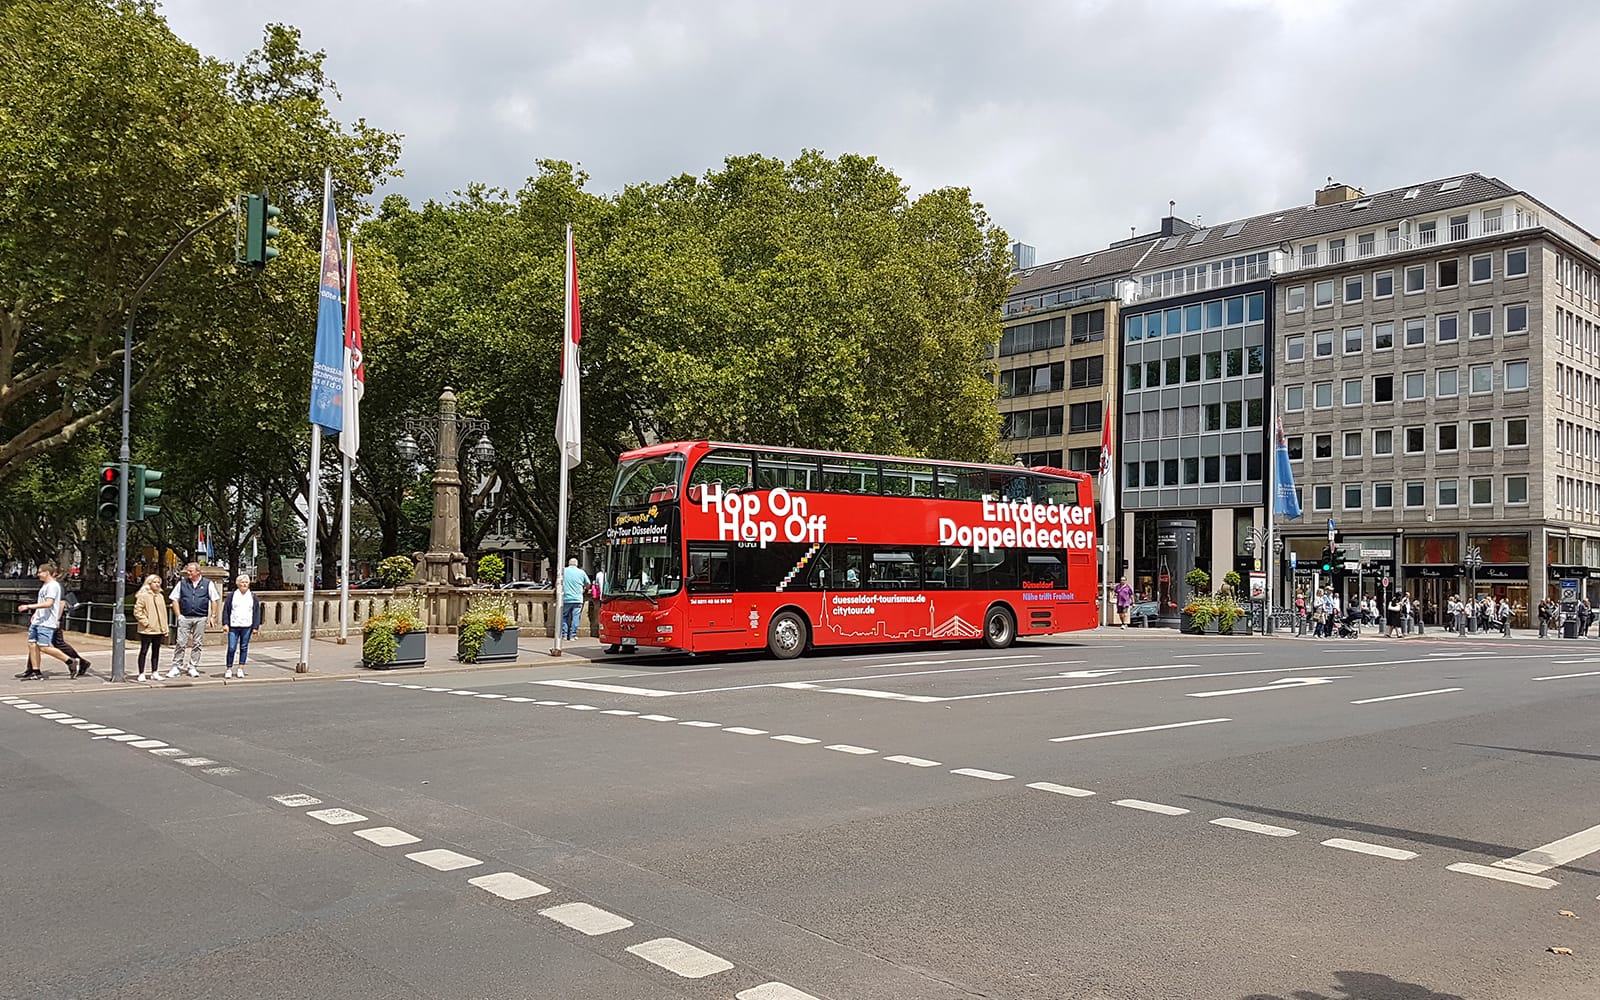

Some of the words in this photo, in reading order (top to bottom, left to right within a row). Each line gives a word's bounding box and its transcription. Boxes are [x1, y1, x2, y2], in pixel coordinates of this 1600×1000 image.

[312, 377, 343, 391] sseldo
[701, 483, 761, 522] Hop
[768, 487, 807, 517] On
[982, 495, 1092, 525] Entdecker
[606, 527, 631, 538] City-Tour
[632, 524, 668, 535] Düsseldorf
[718, 511, 777, 549] Hop
[784, 515, 827, 543] Off
[939, 518, 1094, 553] Doppeldecker
[1022, 581, 1054, 589] Düsseldorf
[832, 594, 926, 604] duesseldorf-tourismus.de
[1022, 592, 1038, 601] Nähe
[1039, 592, 1052, 601] trifft
[1053, 592, 1075, 601] Freiheit
[832, 605, 875, 616] citytour.de
[612, 614, 644, 624] citytour.de
